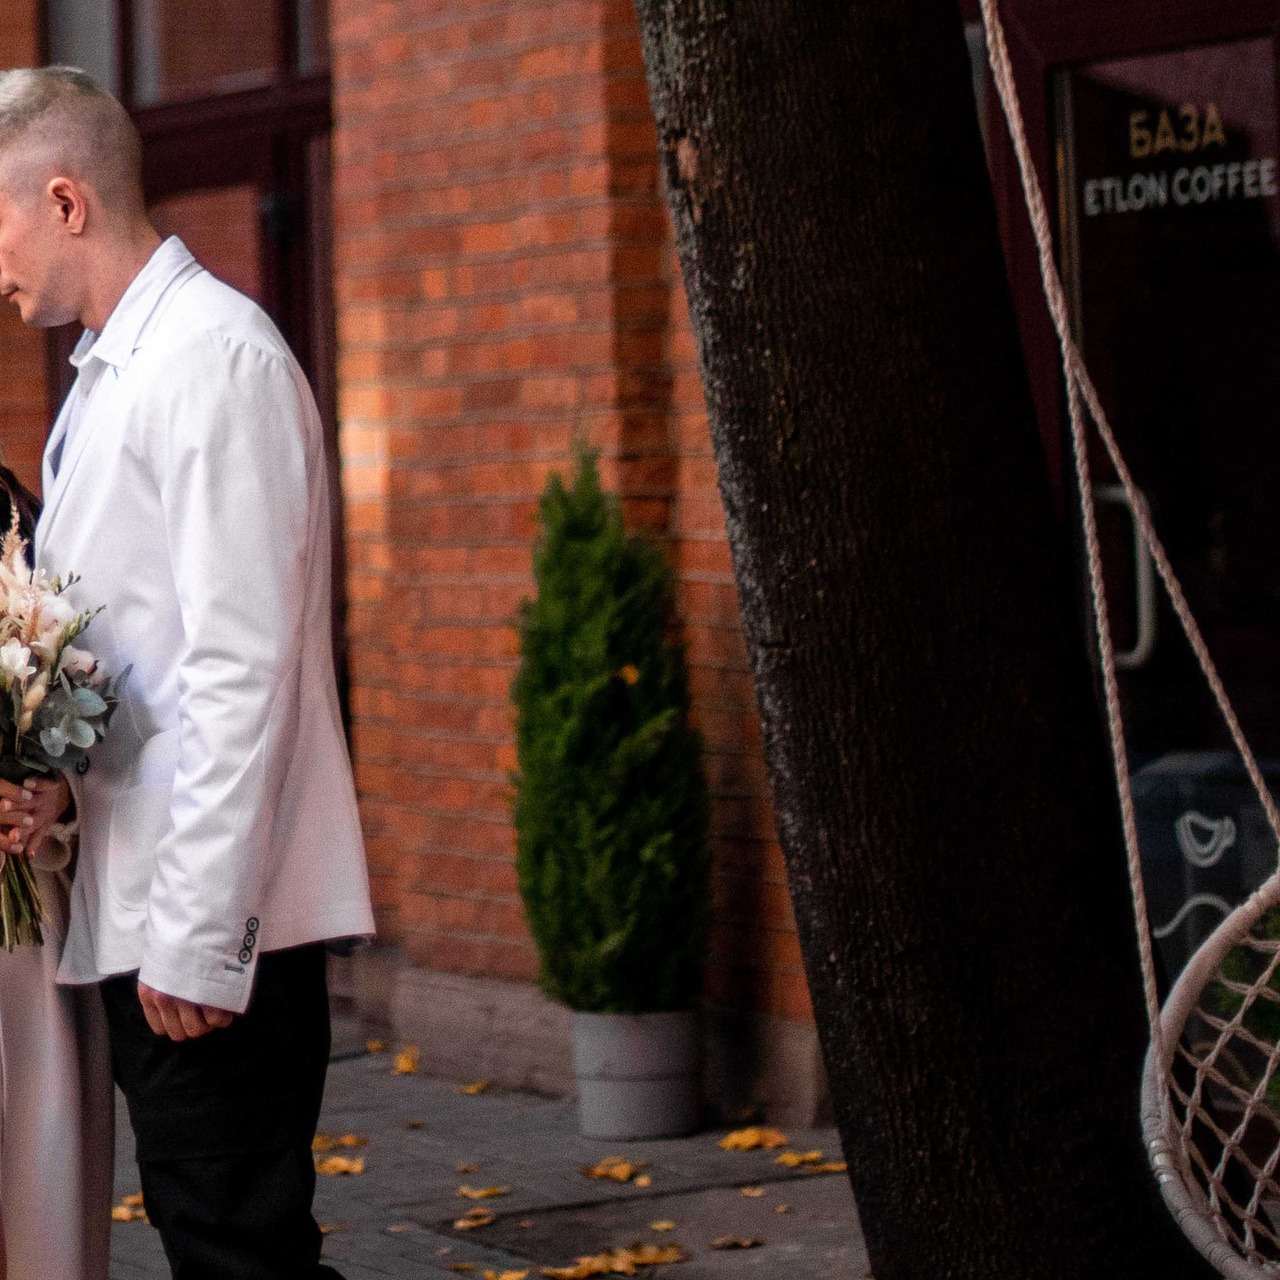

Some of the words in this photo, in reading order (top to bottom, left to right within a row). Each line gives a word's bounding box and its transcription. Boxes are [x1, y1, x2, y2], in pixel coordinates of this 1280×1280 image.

[1129, 102, 1227, 158] БАЗА
[1084, 172, 1168, 215] ETLON
[1173, 158, 1278, 206] COFFEE
